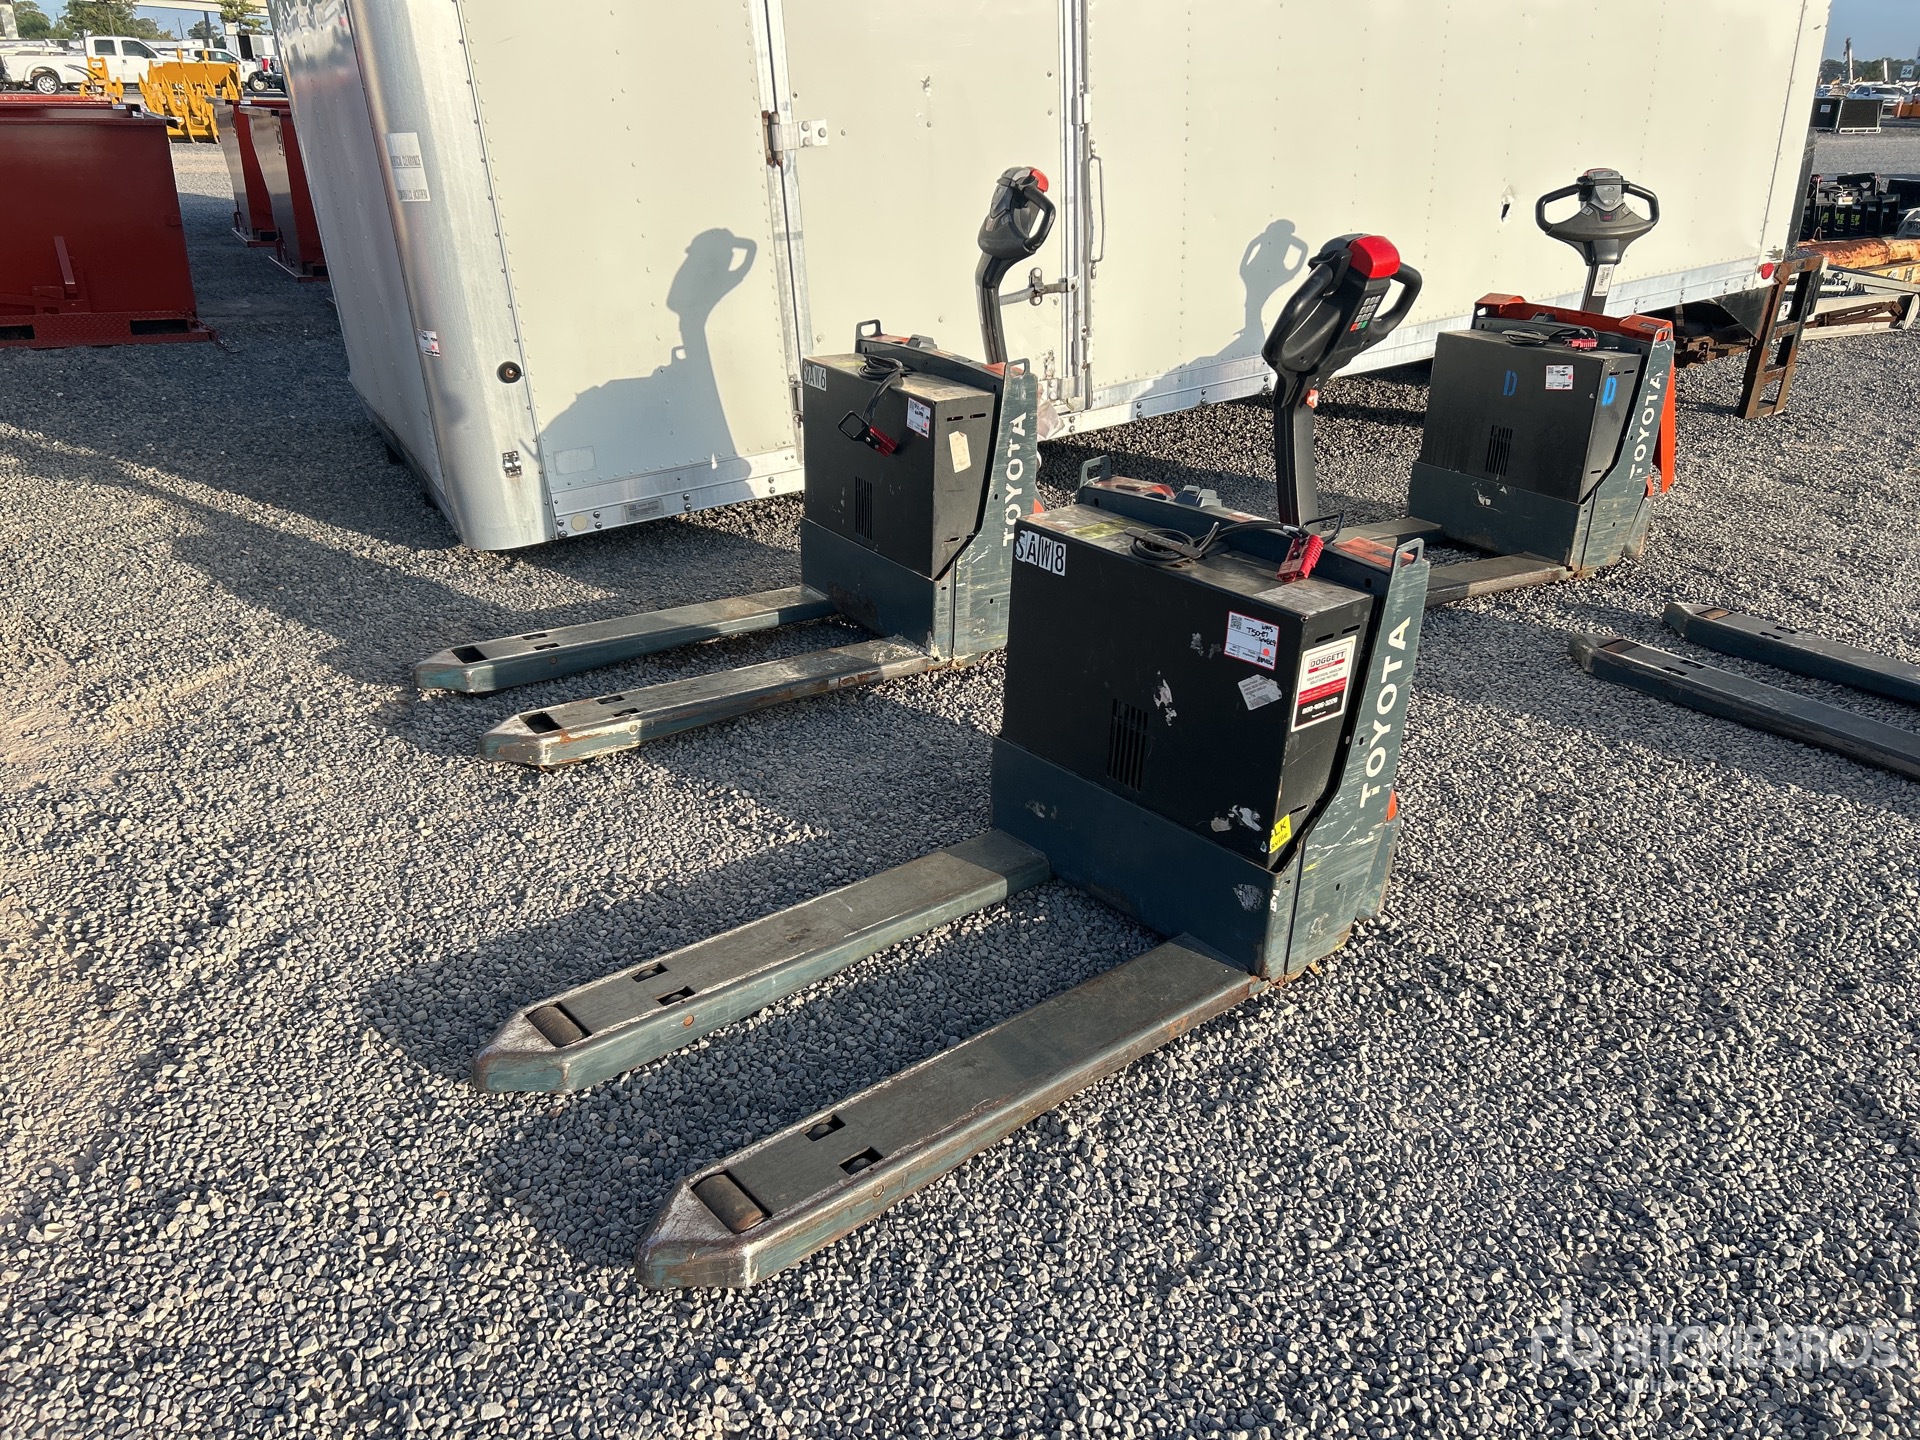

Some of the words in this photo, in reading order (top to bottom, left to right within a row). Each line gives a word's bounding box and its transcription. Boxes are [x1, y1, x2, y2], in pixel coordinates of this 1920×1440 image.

[1503, 370, 1518, 397] D
[1601, 376, 1617, 407] D
[1629, 370, 1664, 480] TOYOTA
[1003, 412, 1027, 547] TOYOTA
[1015, 531, 1066, 575] SAW8
[1310, 651, 1346, 668] DOGGETT
[1360, 617, 1411, 808] TOYOTA
